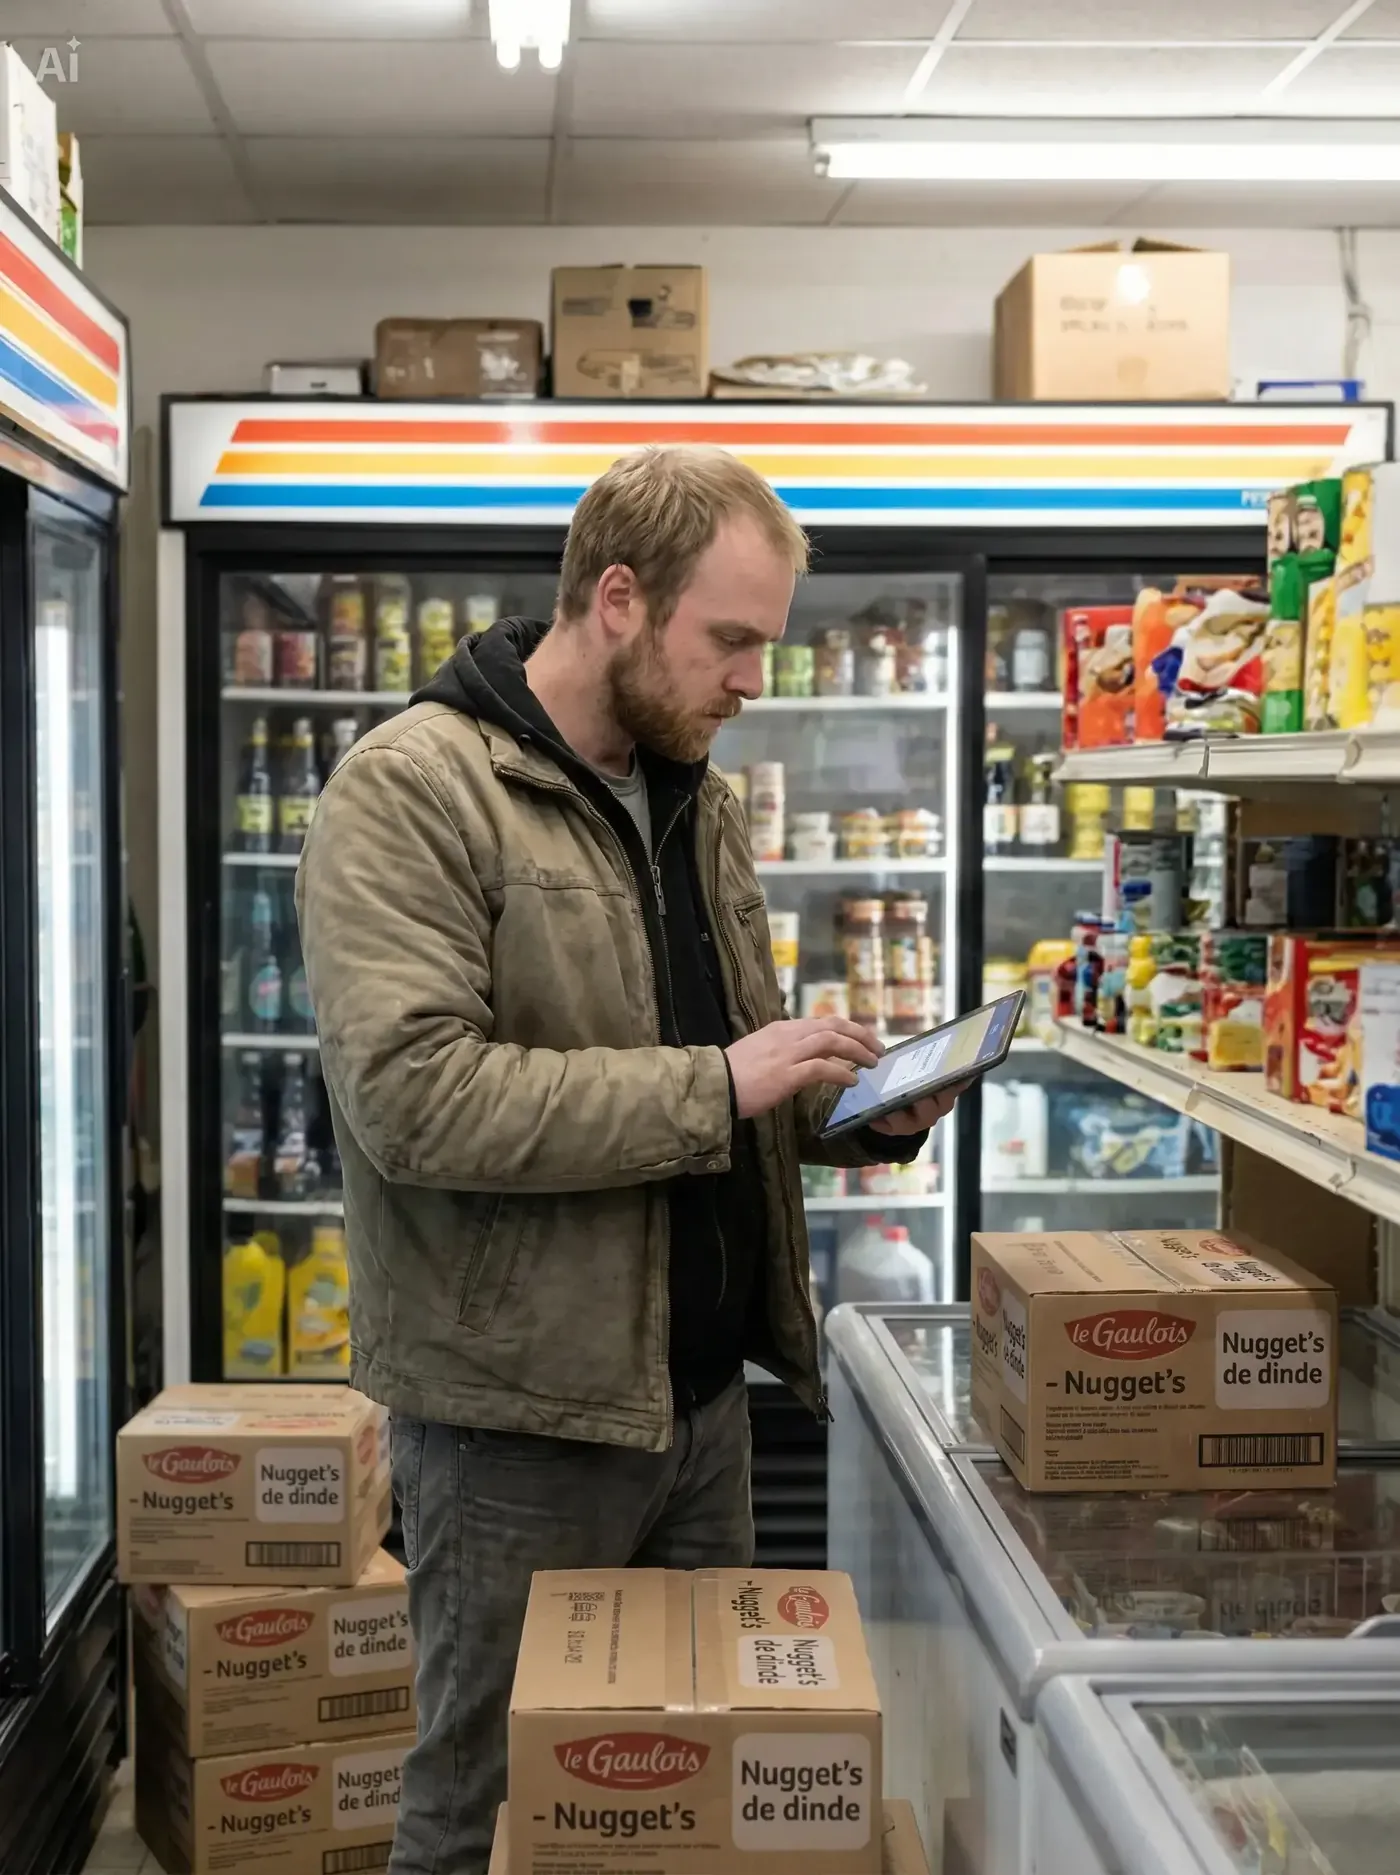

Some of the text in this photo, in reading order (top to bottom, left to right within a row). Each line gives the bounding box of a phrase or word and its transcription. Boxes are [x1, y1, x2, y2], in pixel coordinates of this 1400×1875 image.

[1073, 1317, 1188, 1347] le Gaulois
[1223, 1330, 1325, 1360] Nugget's
[1065, 1369, 1186, 1401] Nugget's
[1223, 1361, 1322, 1385] de dinde
[162, 1451, 236, 1474] Gaulois
[261, 1465, 339, 1486] Nugget's
[142, 1491, 234, 1514] Nugget's
[262, 1488, 339, 1505] de dinde
[731, 1587, 772, 1628] Nugget's
[236, 1613, 309, 1640] Gaulois
[333, 1610, 409, 1636] Nugget's
[335, 1636, 407, 1658] de dinde
[754, 1639, 787, 1684] de dinde
[217, 1650, 307, 1679] Nugget's
[786, 1639, 827, 1686] Nugget's
[564, 1740, 700, 1777] le Gaulois
[240, 1766, 314, 1797] Gaulois
[741, 1760, 863, 1791] Nugget's
[338, 1785, 401, 1811] de dind
[742, 1795, 860, 1821] de dinde
[220, 1804, 312, 1834] Nugget's
[554, 1802, 696, 1837] Nugget's
